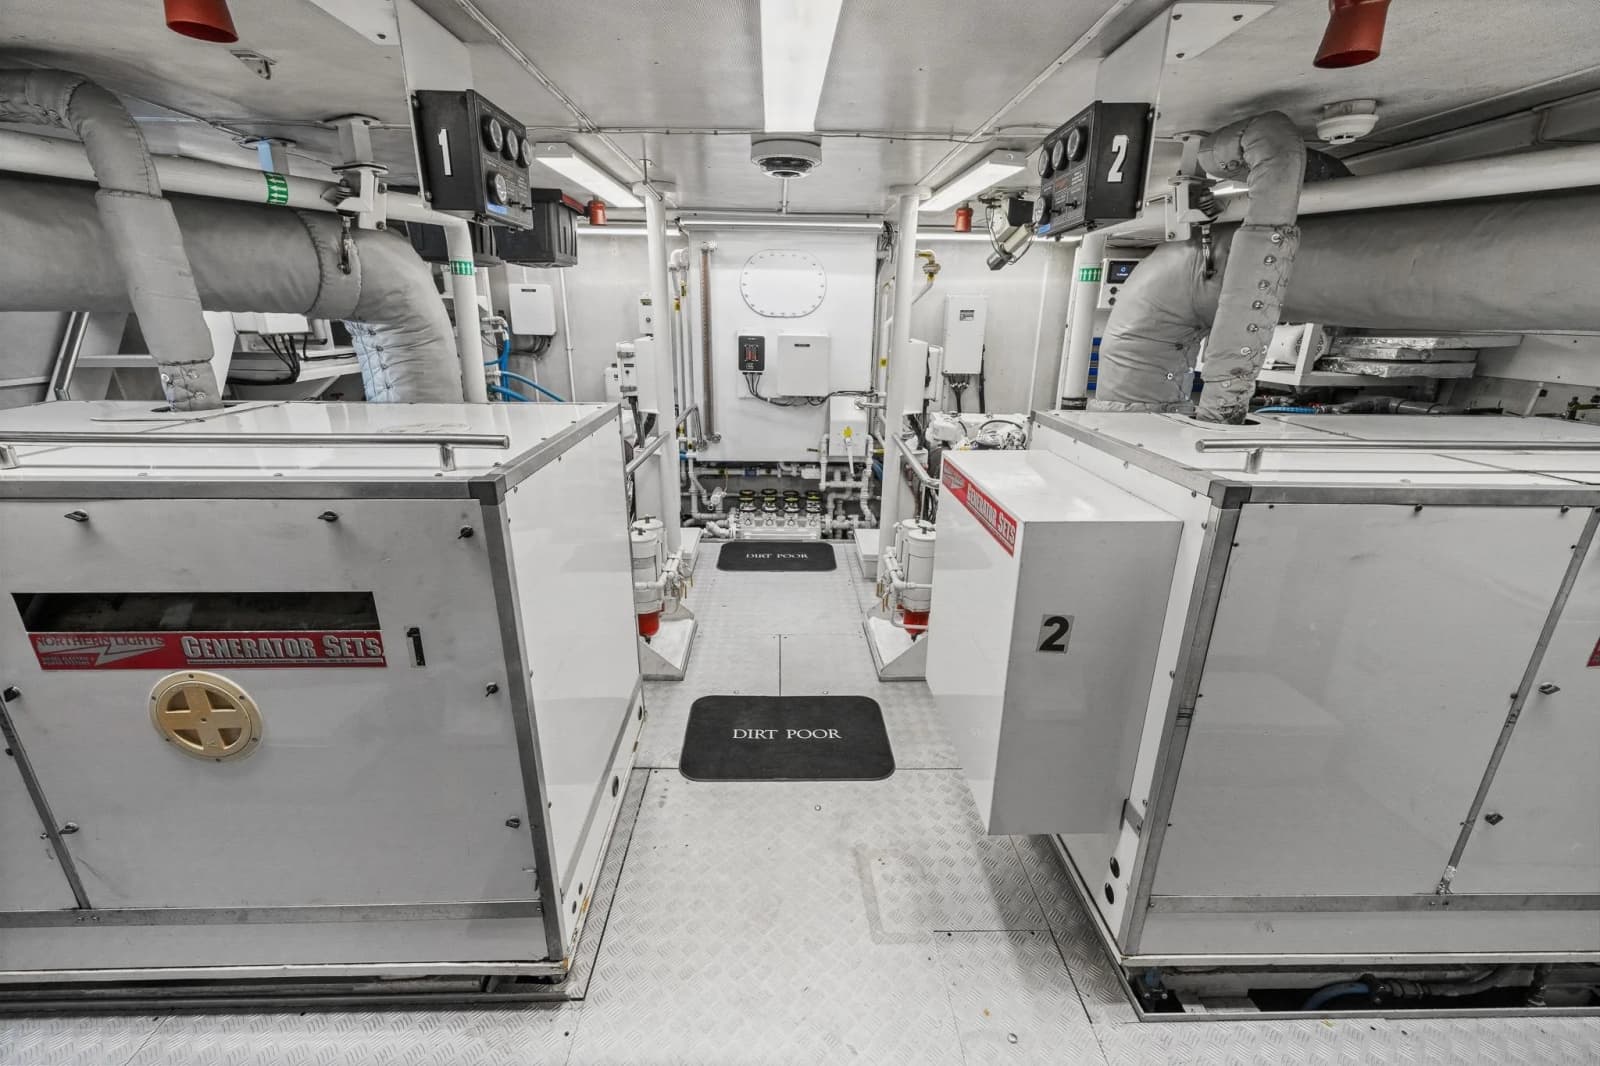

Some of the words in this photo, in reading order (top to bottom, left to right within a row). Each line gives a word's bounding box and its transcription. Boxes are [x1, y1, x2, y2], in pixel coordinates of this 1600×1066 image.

[438, 128, 452, 176] 1
[1107, 134, 1129, 183] 2
[967, 483, 997, 528] GENERATOR
[998, 511, 1016, 545] SETS
[113, 635, 166, 647] LIGHTS
[181, 635, 317, 659] GENERATOR
[321, 634, 384, 658] SETS
[406, 627, 426, 667] 1
[1039, 616, 1069, 651] 2
[732, 728, 779, 740] DIRT
[785, 728, 843, 740] POOR
